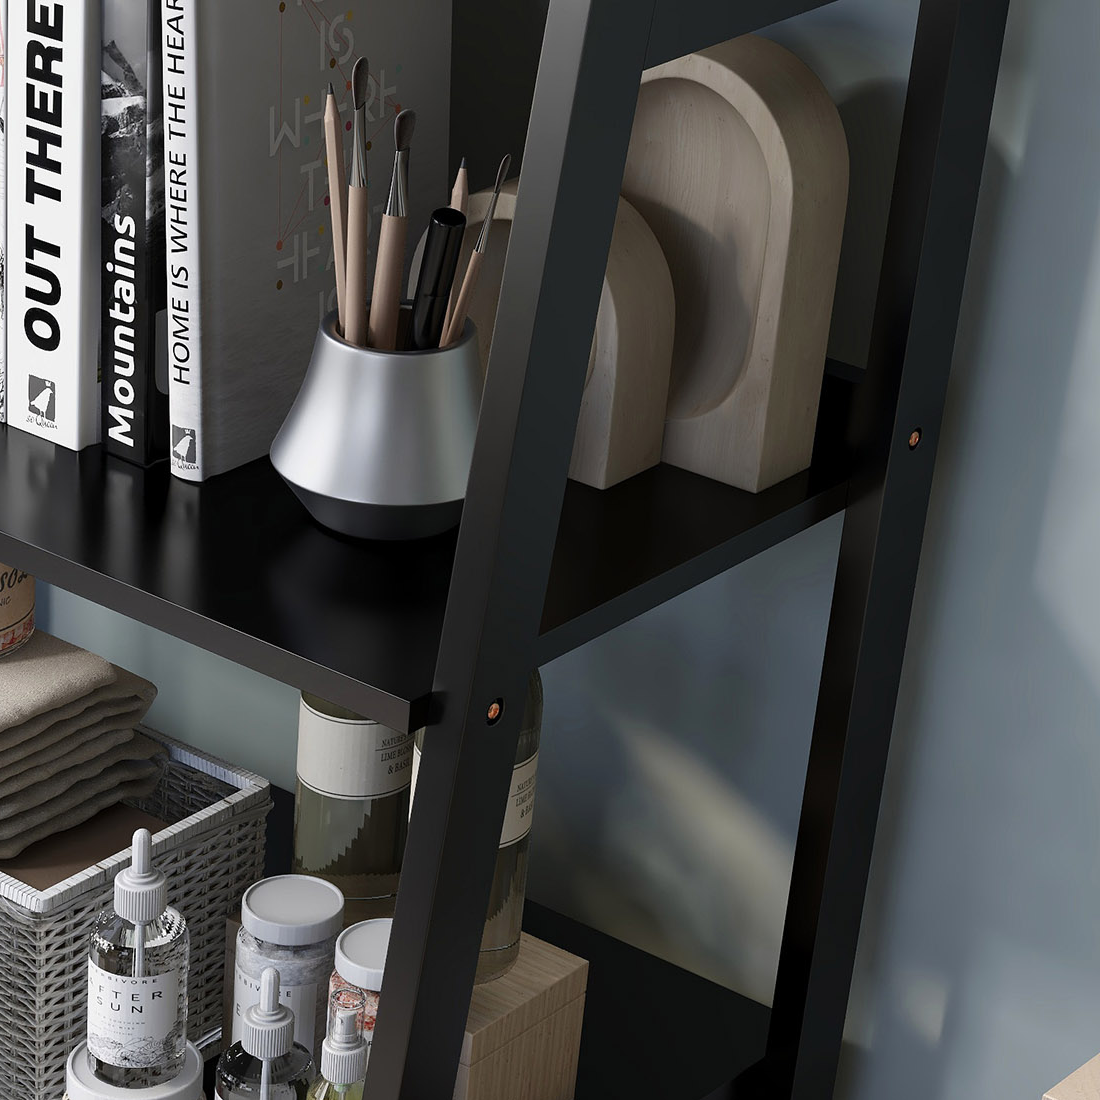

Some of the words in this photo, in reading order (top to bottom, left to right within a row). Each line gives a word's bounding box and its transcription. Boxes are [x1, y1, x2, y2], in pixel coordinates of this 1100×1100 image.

[25, 0, 64, 203] THERE
[168, 82, 186, 141] THE
[169, 150, 188, 255] WHERE
[23, 223, 61, 353] OUT
[171, 263, 189, 287] IS
[106, 213, 136, 447] Mountains
[172, 300, 190, 385] HOME
[90, 977, 163, 1000] AFTER
[96, 996, 143, 1014] SUN
